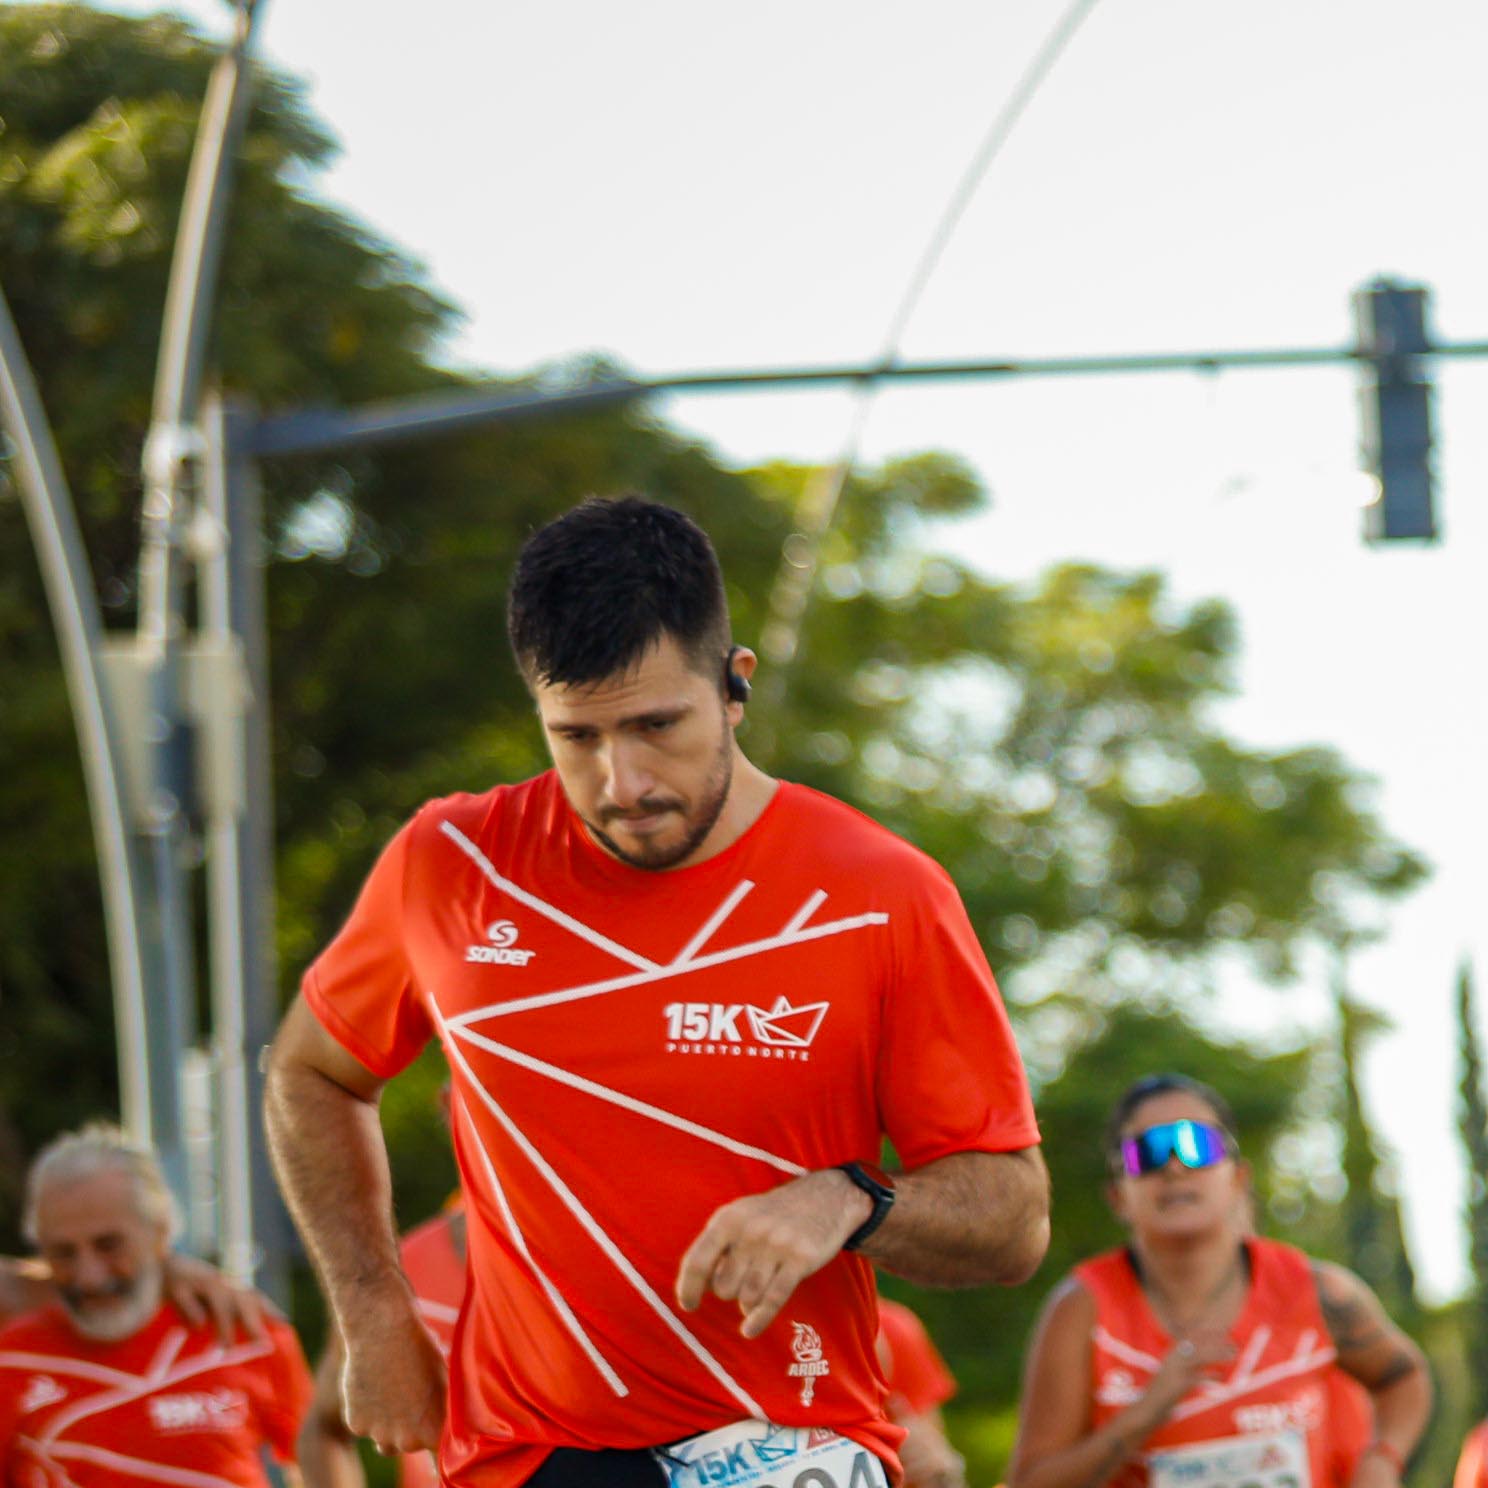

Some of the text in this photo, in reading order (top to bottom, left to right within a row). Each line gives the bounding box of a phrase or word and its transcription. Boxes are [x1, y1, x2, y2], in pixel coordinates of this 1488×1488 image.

[664, 1003, 743, 1042] 15K
[665, 1042, 810, 1062] PUERTO NORTE
[691, 1441, 751, 1485] 15K
